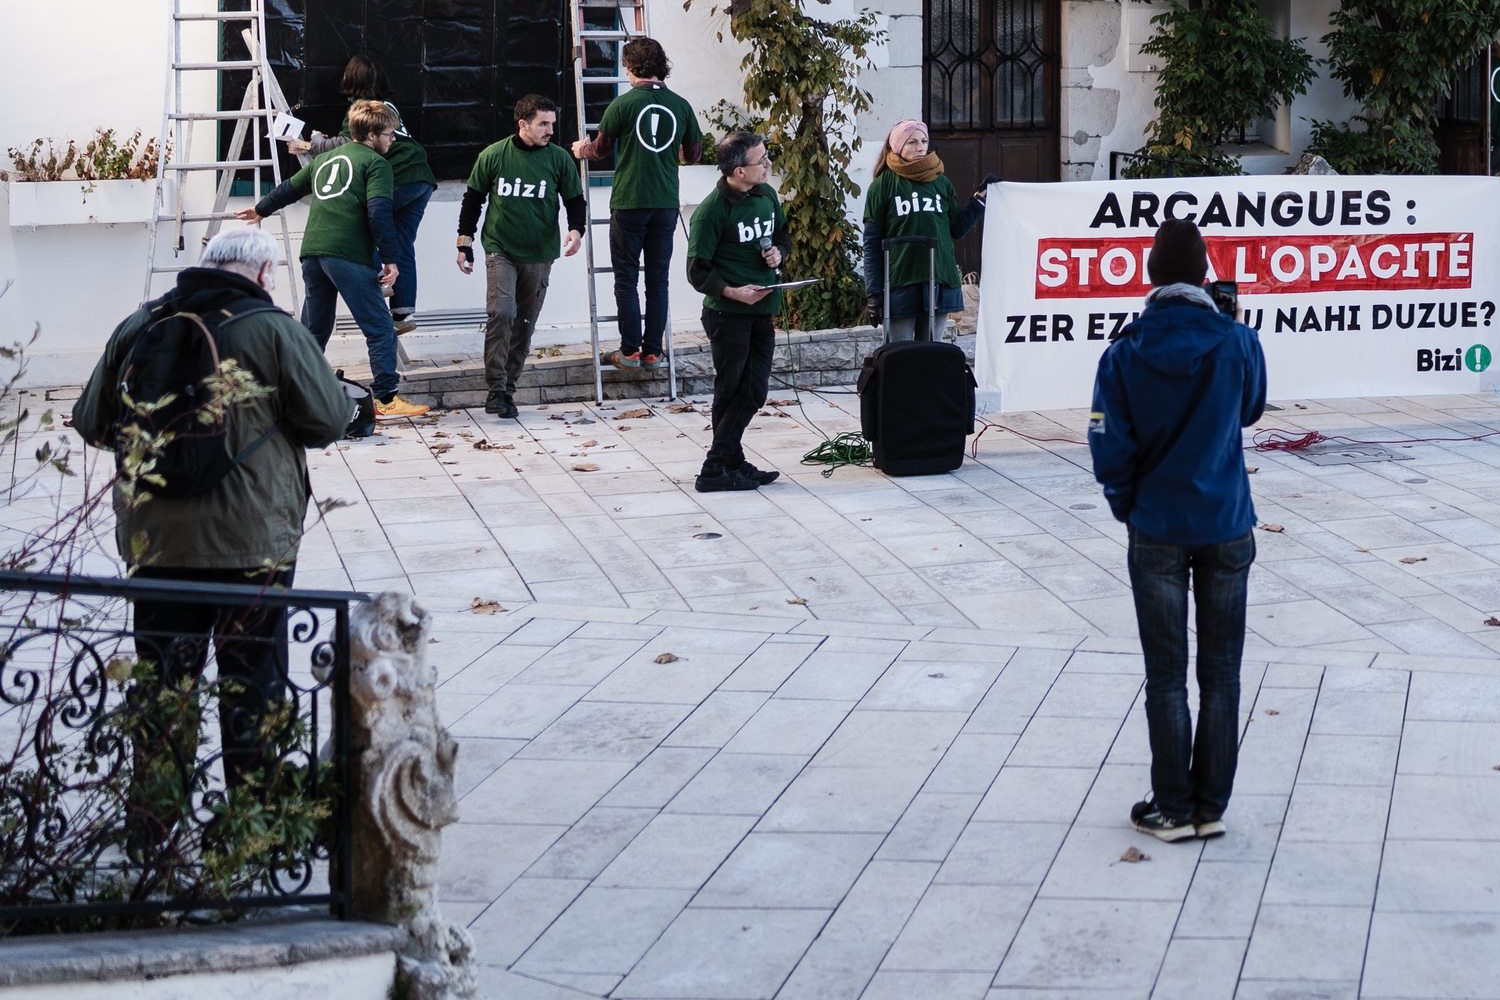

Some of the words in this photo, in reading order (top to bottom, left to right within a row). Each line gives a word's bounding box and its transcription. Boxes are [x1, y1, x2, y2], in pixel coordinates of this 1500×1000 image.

[497, 177, 547, 198] bizi
[894, 191, 943, 217] bizi
[1090, 190, 1391, 228] ARCANGUES
[737, 211, 775, 243] bizi
[1235, 232, 1472, 284] L'OPACITÉ
[1005, 314, 1075, 344] ZER
[1275, 304, 1359, 334] NAHI
[1372, 301, 1496, 331] DUZUE?
[1417, 348, 1462, 372] Bizi
